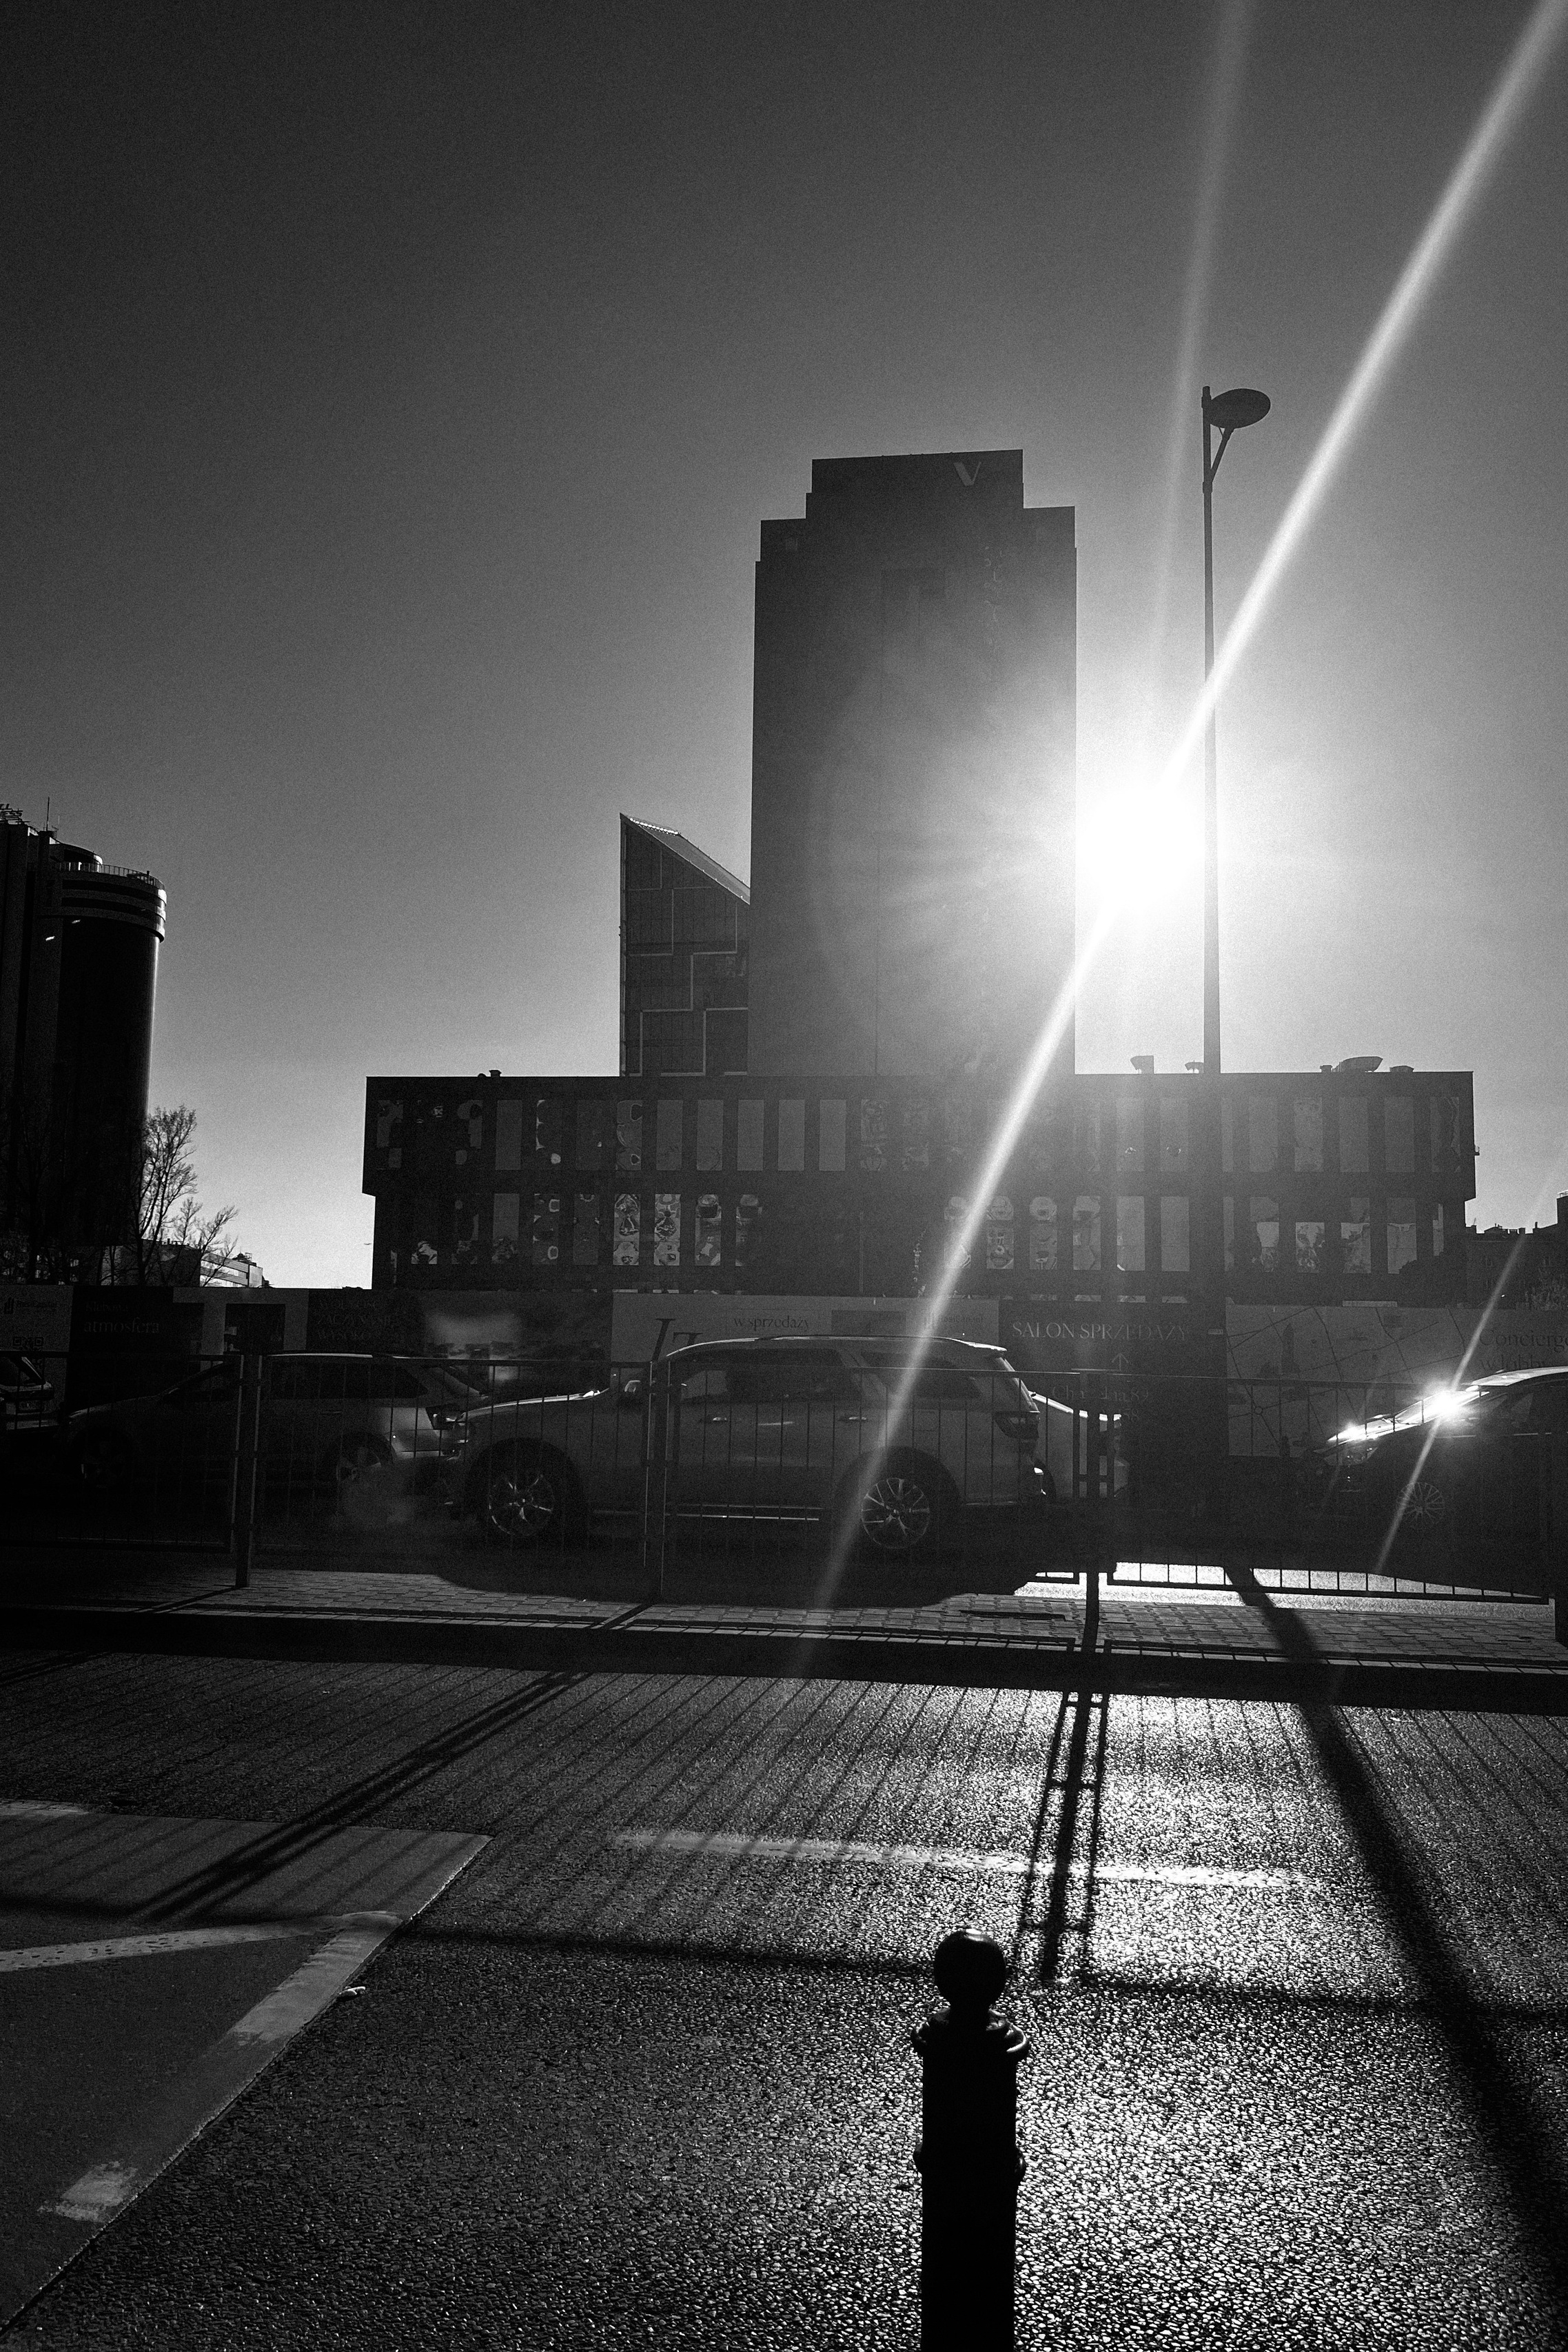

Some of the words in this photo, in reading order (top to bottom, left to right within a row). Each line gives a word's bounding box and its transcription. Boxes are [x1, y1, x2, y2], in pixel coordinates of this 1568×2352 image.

[953, 460, 982, 487] V
[83, 1316, 160, 1334] atmosfera
[733, 1318, 744, 1327] w
[748, 1315, 810, 1332] sprzedaży
[1012, 1321, 1075, 1339] SALON
